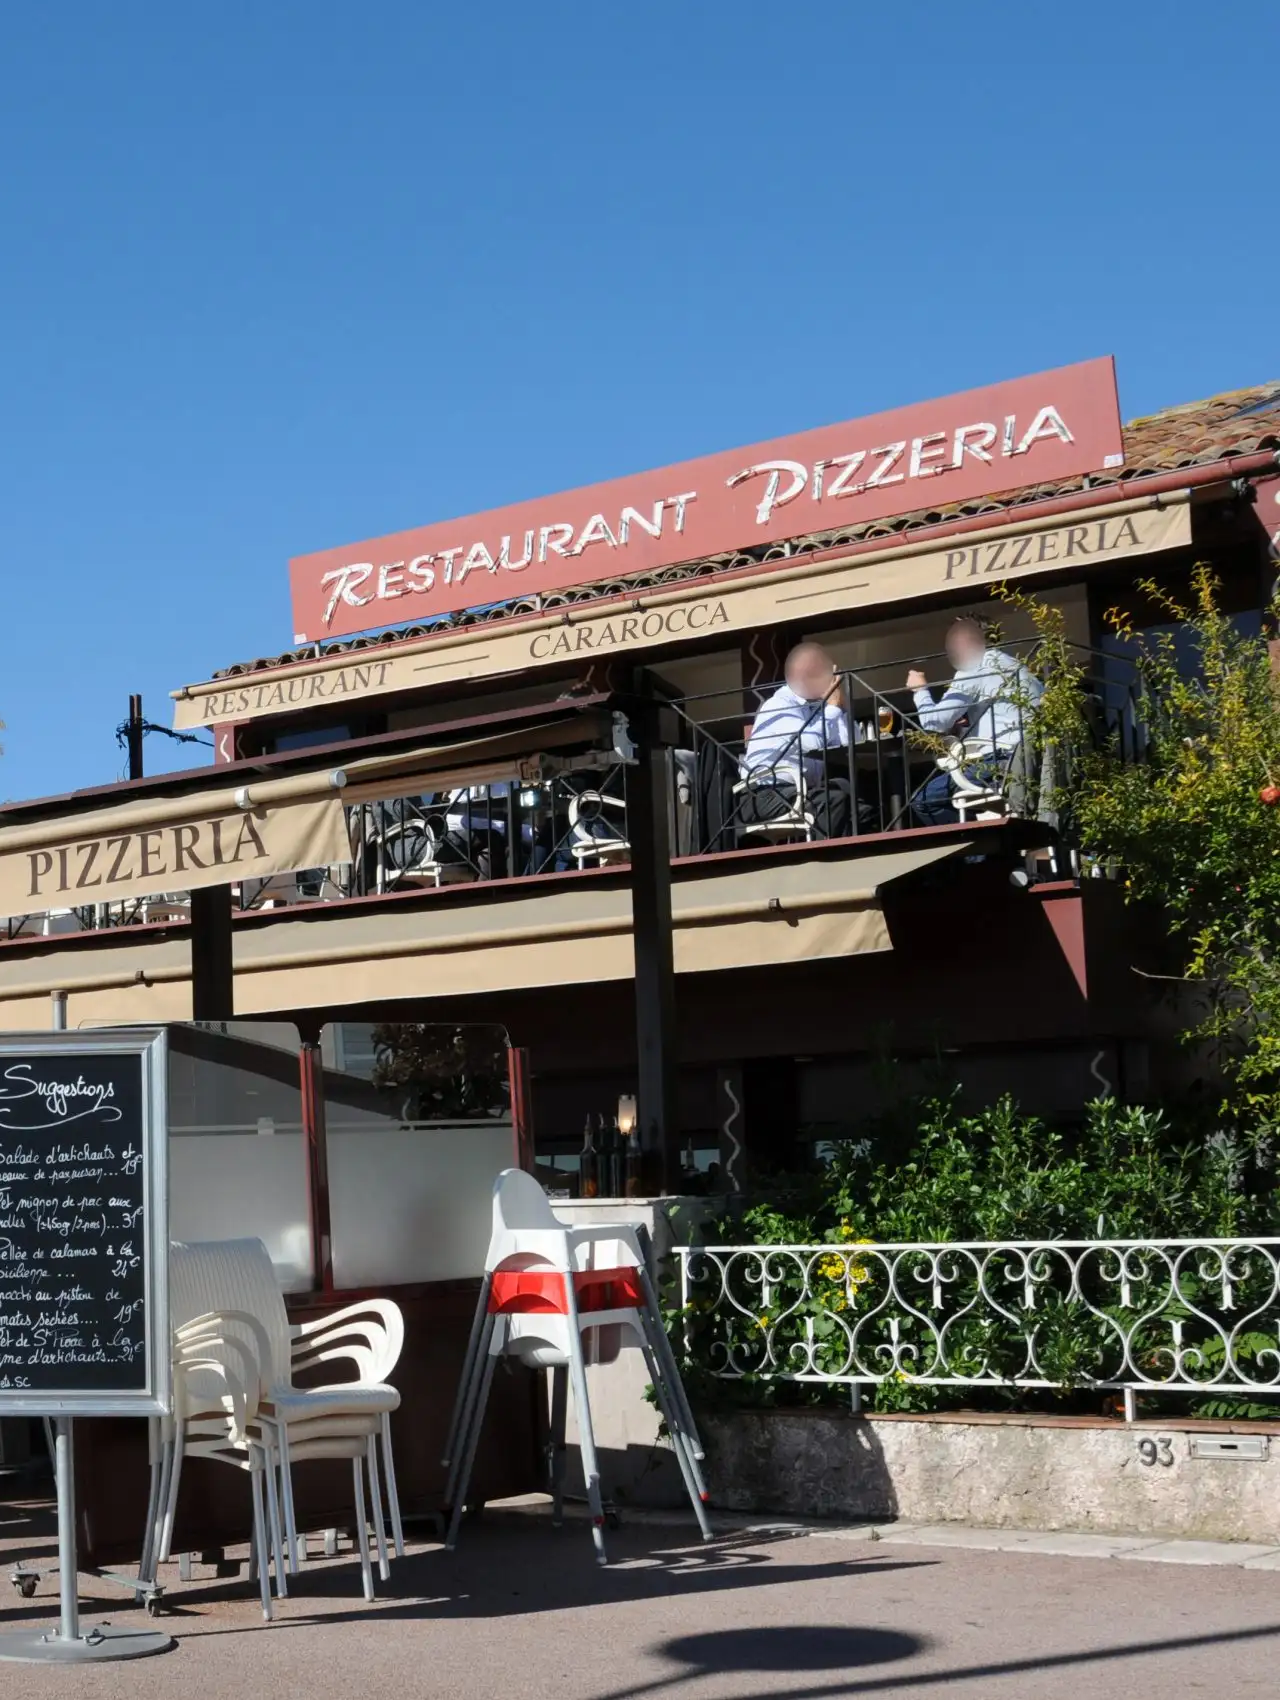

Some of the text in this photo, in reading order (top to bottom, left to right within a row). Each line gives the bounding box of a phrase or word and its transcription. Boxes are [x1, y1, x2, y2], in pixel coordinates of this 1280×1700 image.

[320, 405, 1075, 624] RESTAURANT PIZZERIA
[201, 515, 1143, 720] RESTAURANT CARAROCCA PIZZERIA
[27, 806, 270, 897] PIZZERIA
[46, 1143, 115, 1164] d'artichauts
[121, 1142, 136, 1159] et
[34, 1168, 46, 1180] de
[16, 1196, 59, 1221] mignon
[62, 1195, 75, 1208] de
[108, 1197, 132, 1208] aux
[32, 1248, 45, 1259] de
[50, 1243, 98, 1259] calamars
[106, 1245, 115, 1255] à
[119, 1240, 135, 1255] la
[35, 1291, 53, 1300] au
[105, 1288, 122, 1301] de
[15, 1333, 30, 1347] de
[91, 1334, 101, 1348] à
[14, 1376, 31, 1388] SC
[1138, 1437, 1174, 1467] 93
